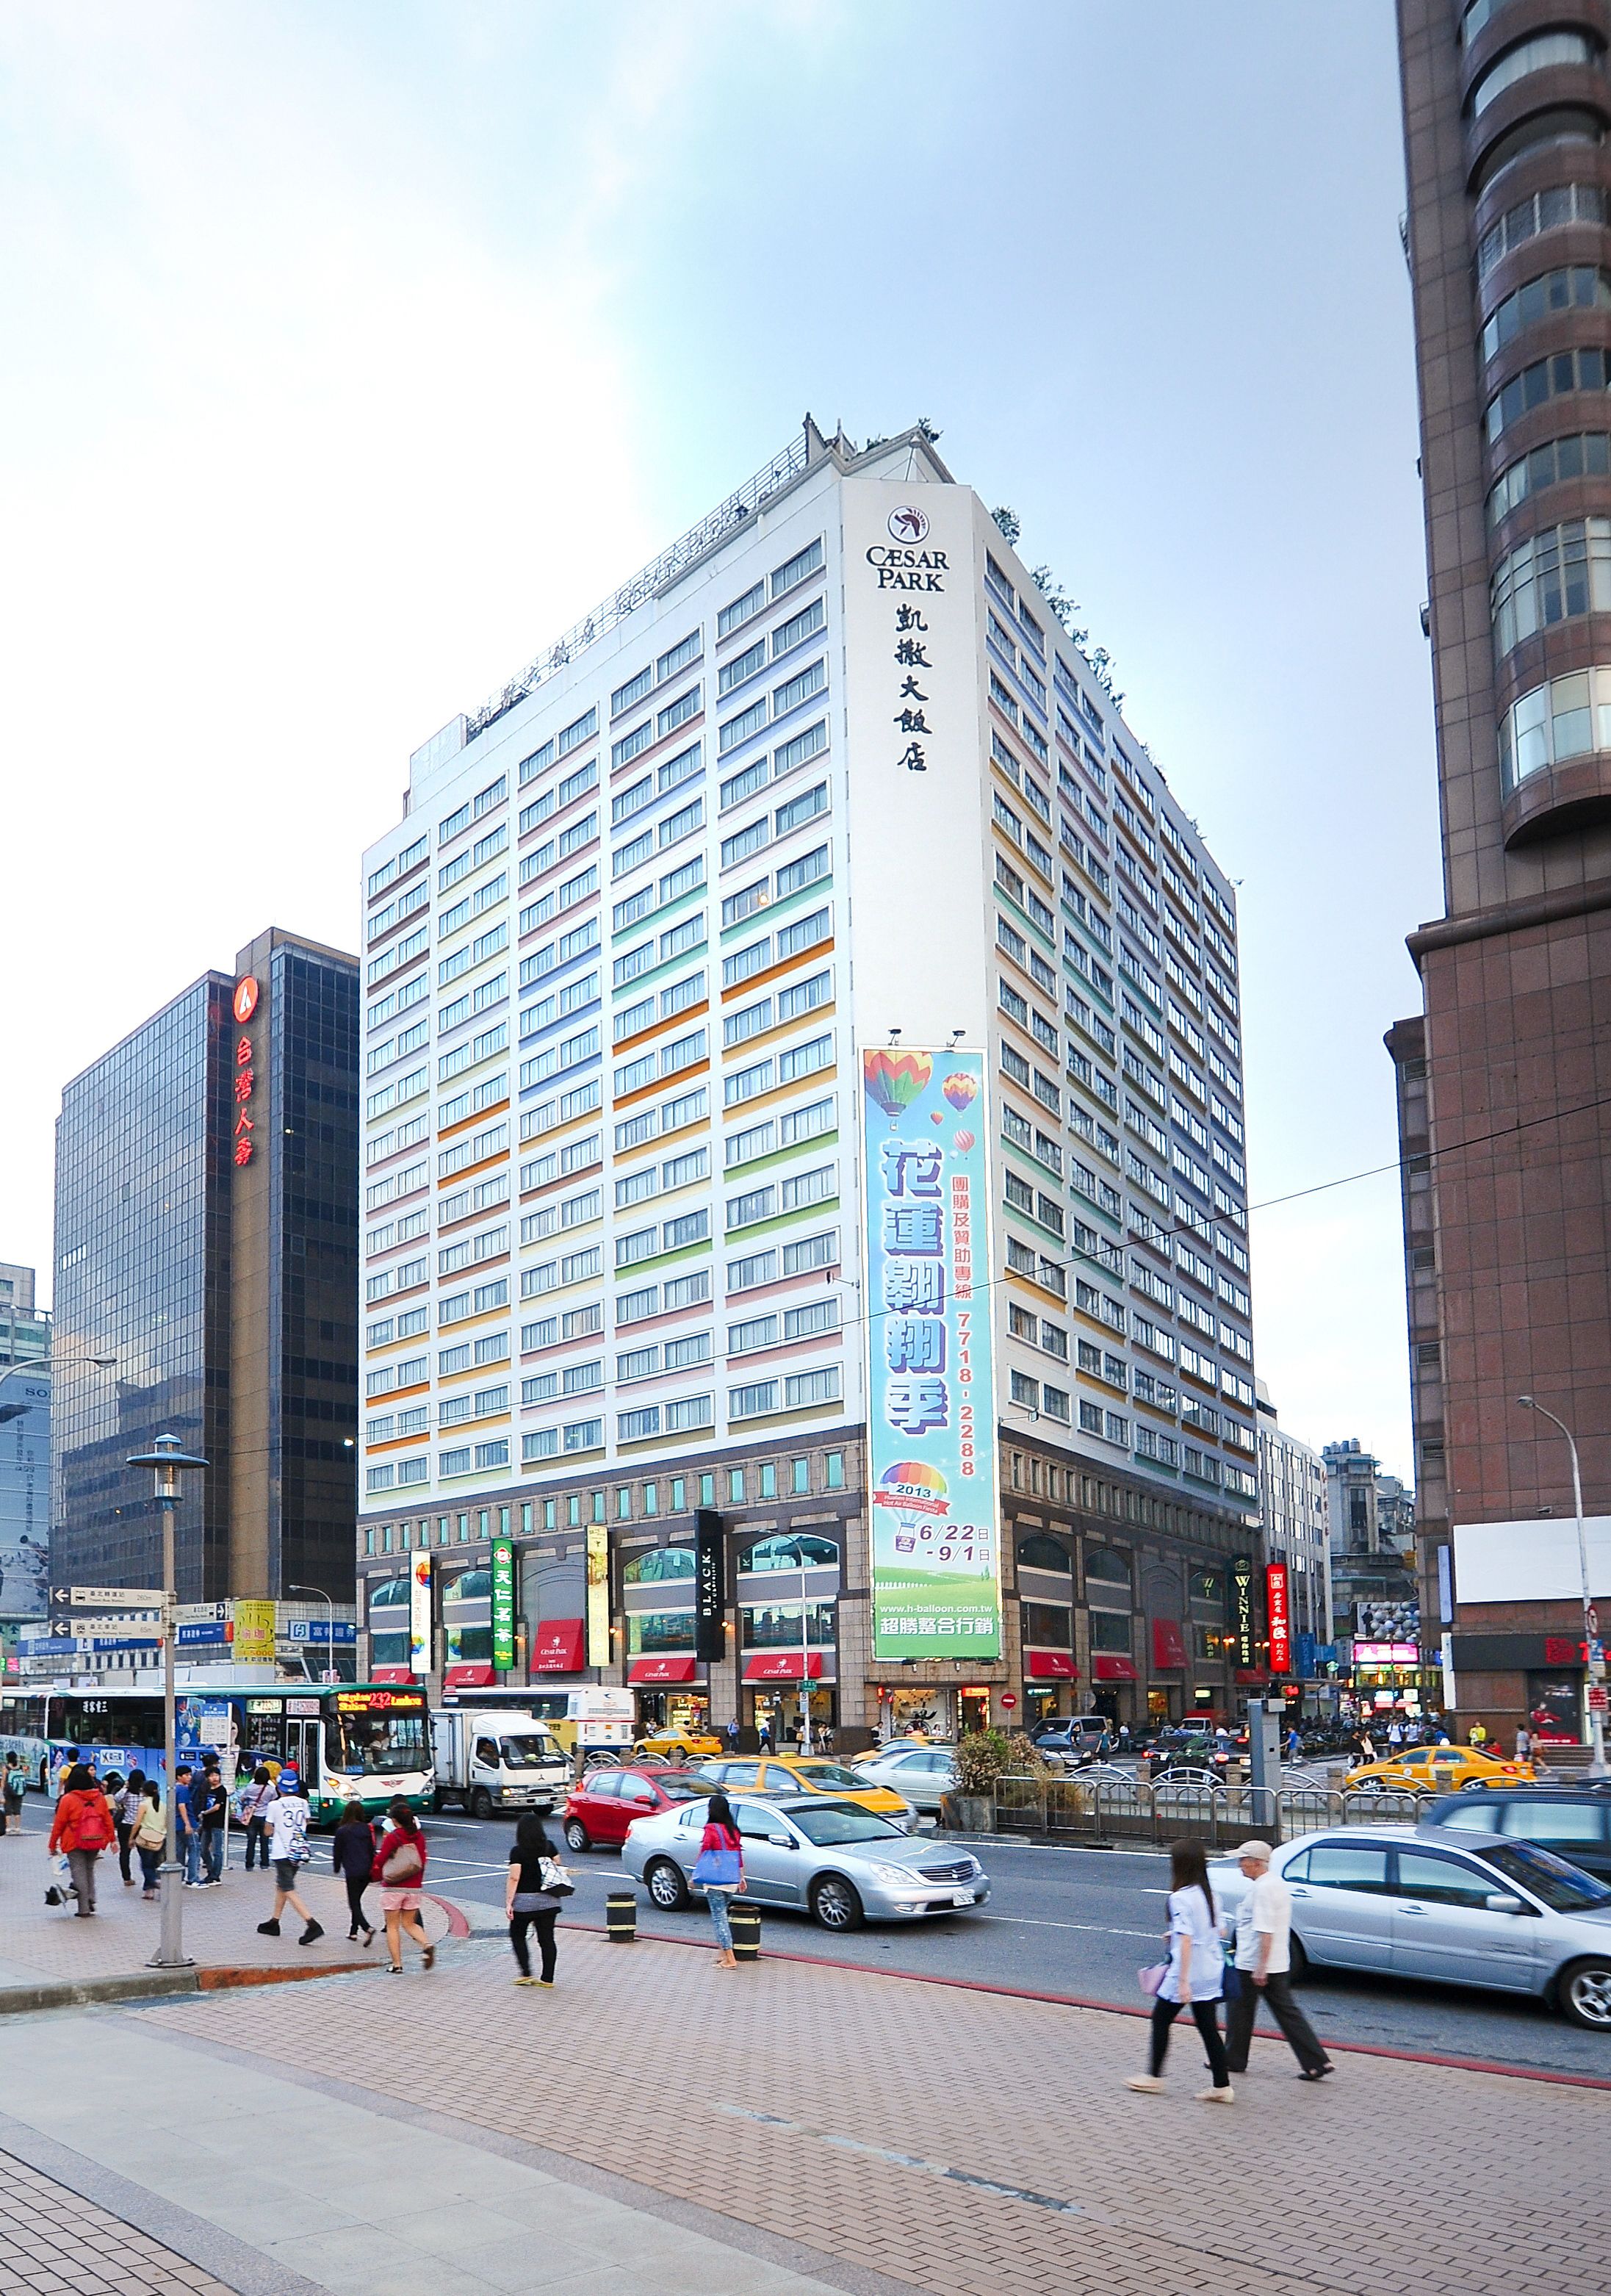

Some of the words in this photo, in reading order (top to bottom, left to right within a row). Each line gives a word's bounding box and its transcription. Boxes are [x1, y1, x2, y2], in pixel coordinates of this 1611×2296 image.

[876, 568, 945, 591] PARK
[894, 602, 933, 772] 凱撒大飯店
[881, 1140, 950, 1436] 花蓮翱翔季
[25, 1387, 51, 1398] SO
[896, 1484, 931, 1498] 2013
[494, 1569, 513, 1643] 天仁茗茶
[880, 1604, 992, 1613] www.h-balloon.com.tw
[1234, 1575, 1251, 1633] WINNIE
[879, 1617, 994, 1635] 超勝整合行銷
[369, 1692, 392, 1706] 232
[284, 1810, 305, 1828] 30
